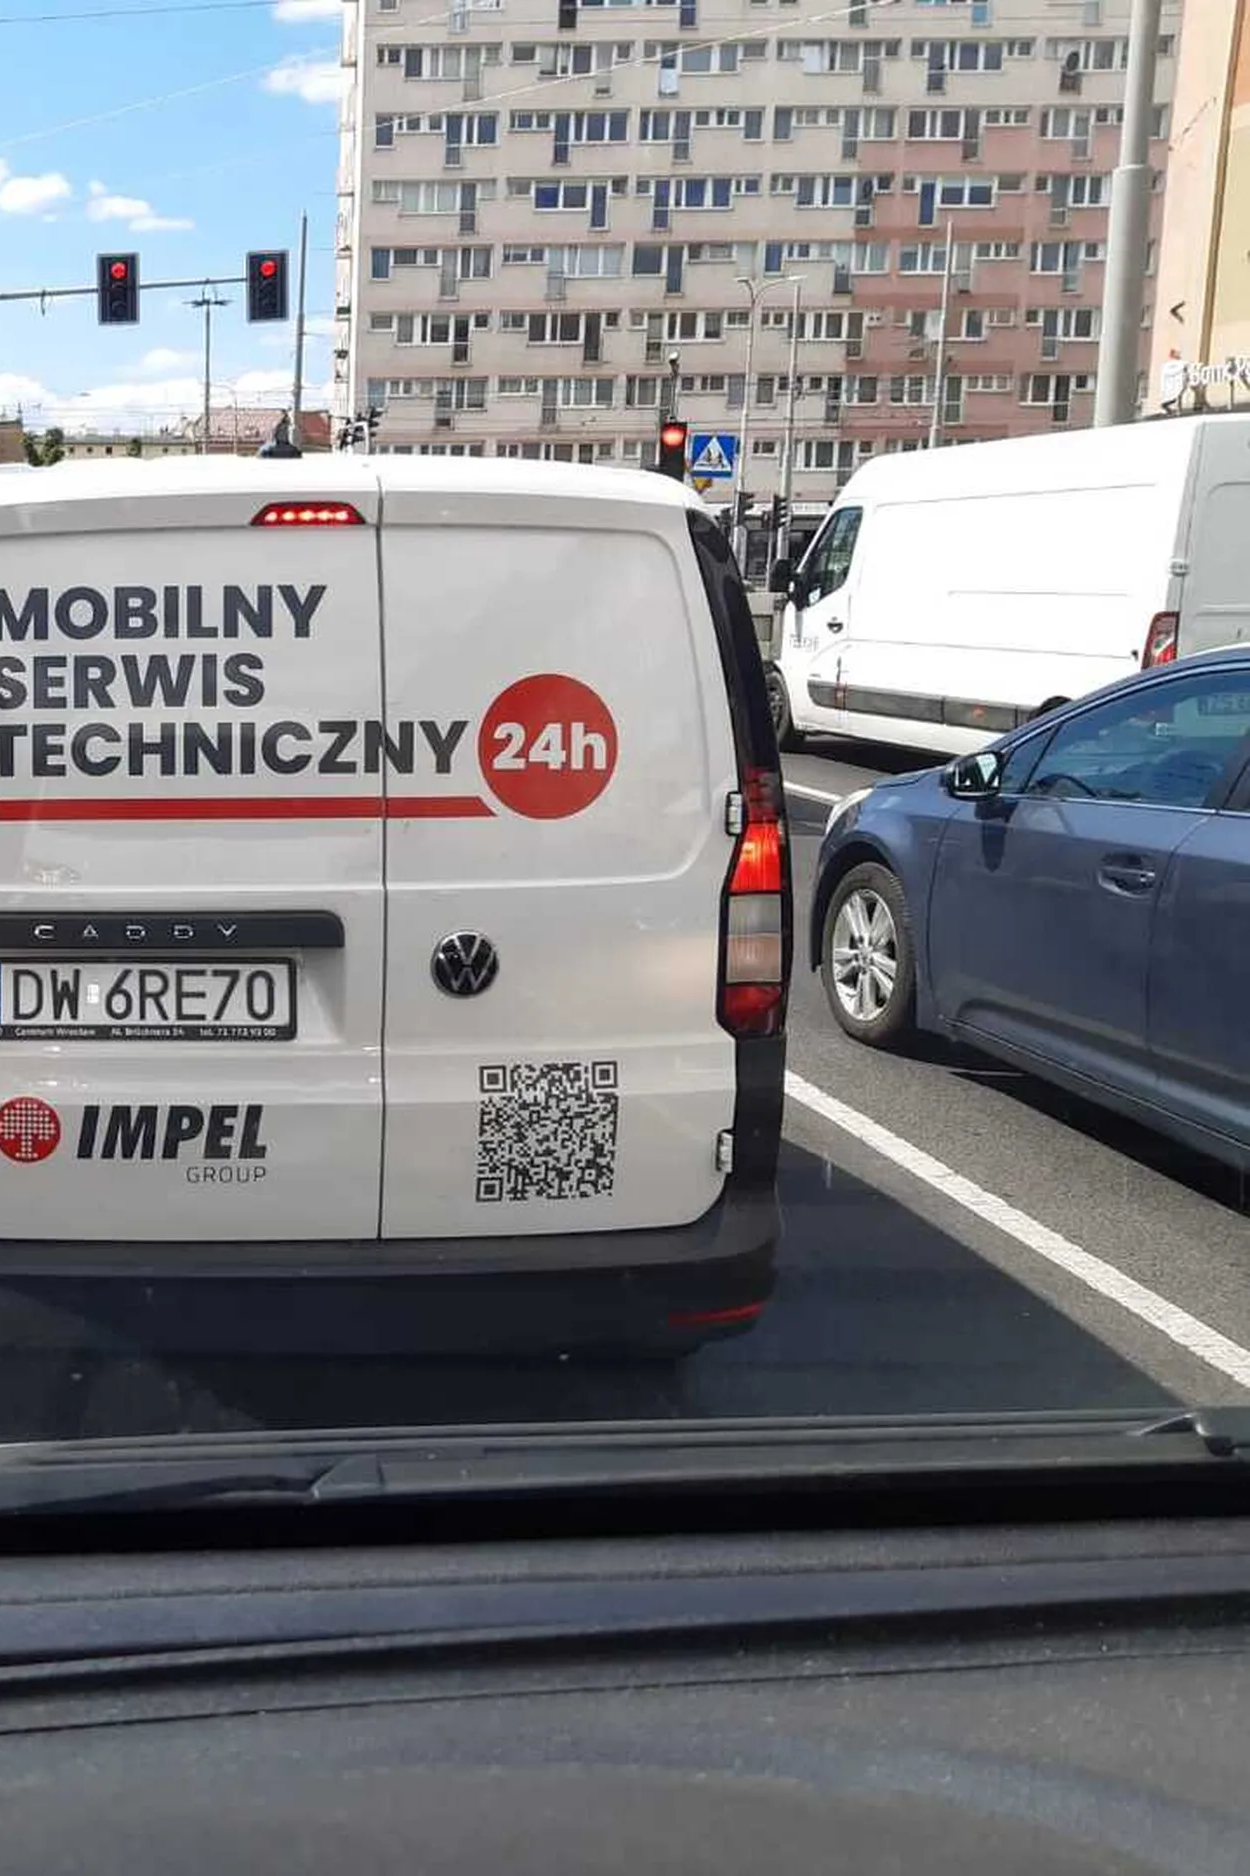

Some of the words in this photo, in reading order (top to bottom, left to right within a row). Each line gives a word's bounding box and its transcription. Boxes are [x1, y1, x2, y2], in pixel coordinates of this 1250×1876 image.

[491, 722, 607, 771] 24h
[34, 924, 238, 938] CADDY
[12, 968, 81, 1020] DW
[105, 968, 276, 1020] 6RE70
[77, 1104, 267, 1159] IMPEL
[186, 1166, 267, 1183] GROUP
